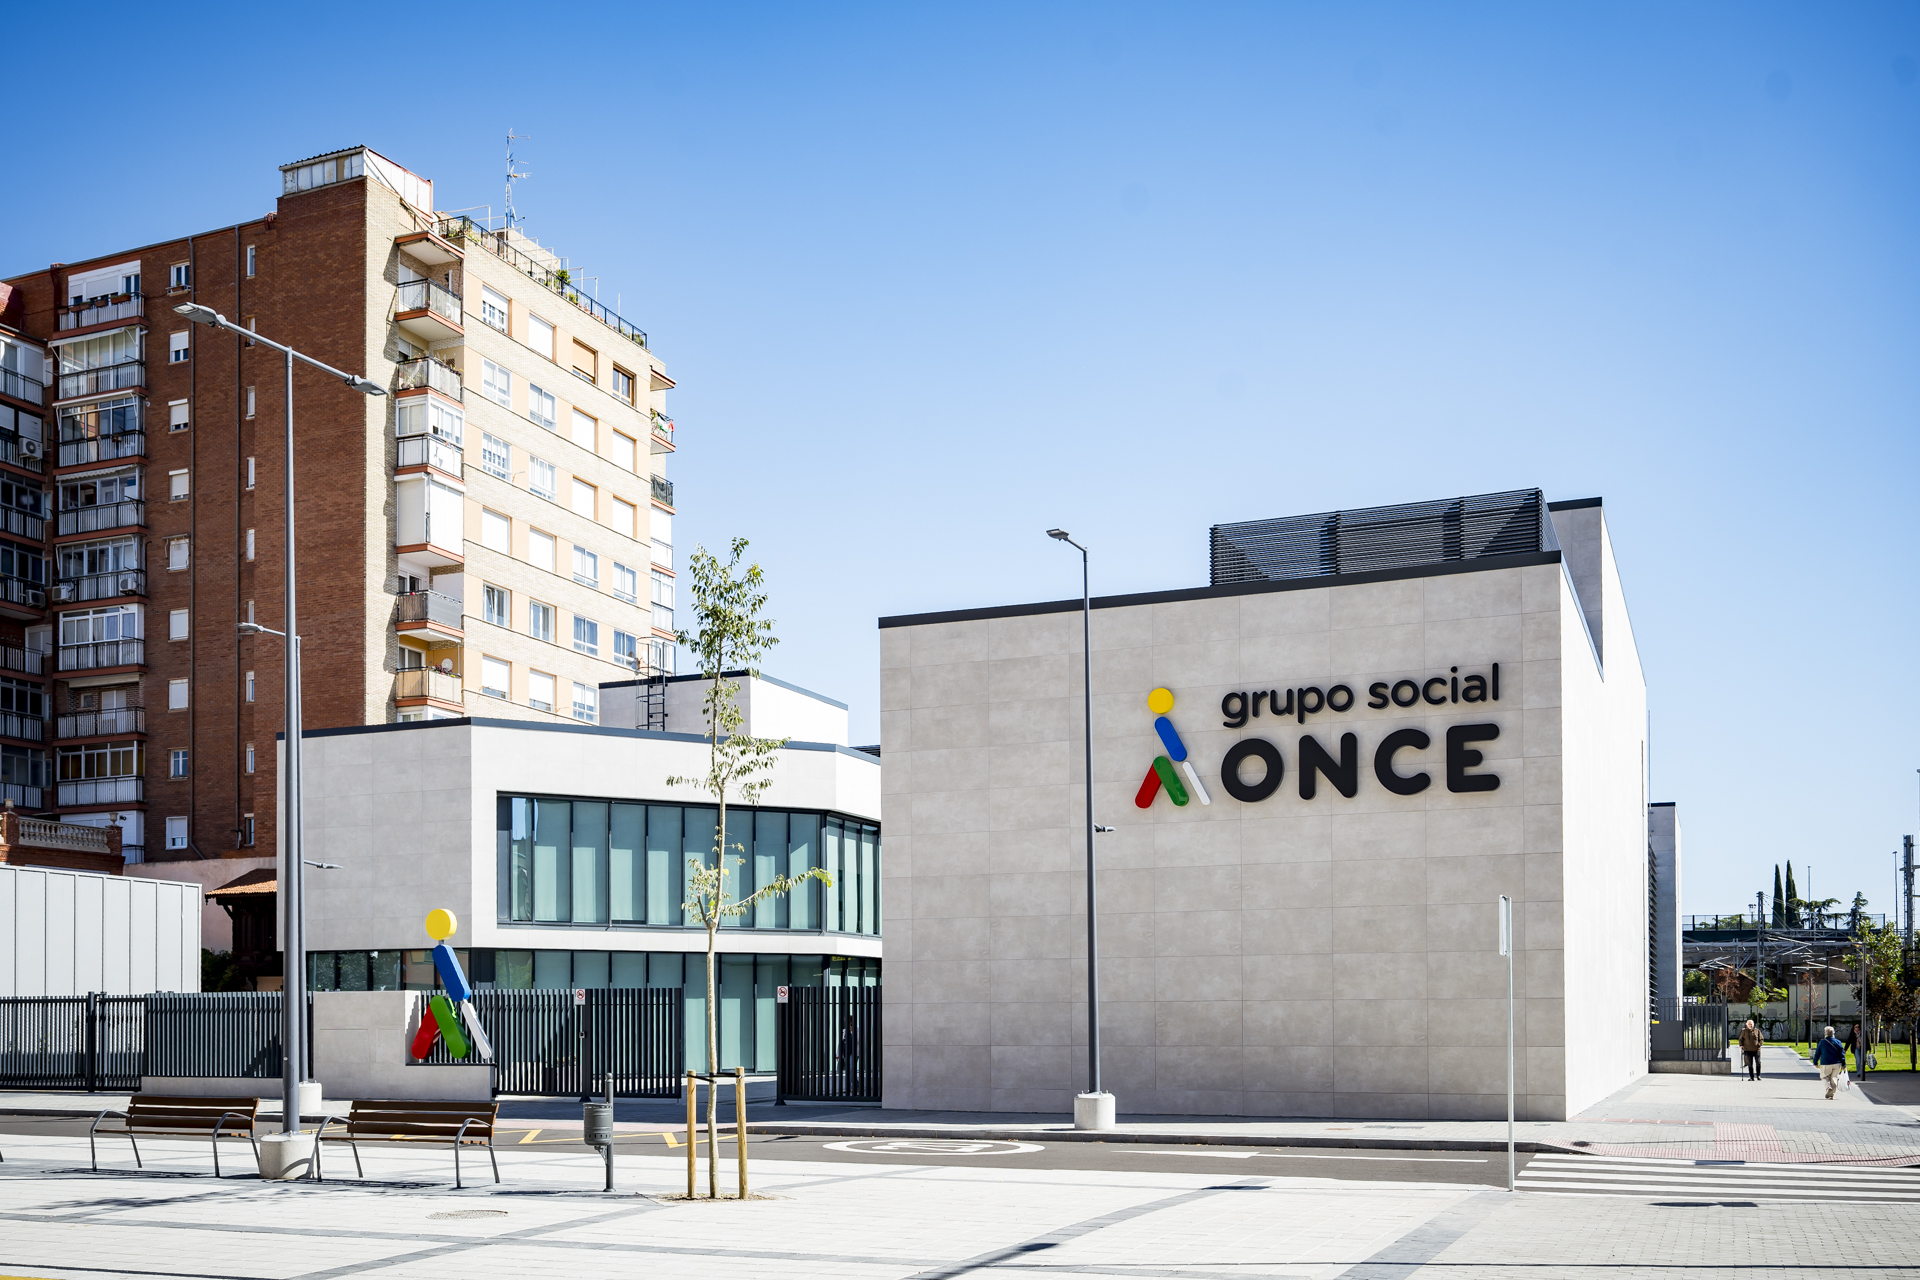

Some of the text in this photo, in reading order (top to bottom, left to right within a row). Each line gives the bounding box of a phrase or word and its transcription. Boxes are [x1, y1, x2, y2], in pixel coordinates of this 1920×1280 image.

[1221, 662, 1500, 729] grupo social
[1220, 722, 1501, 803] ONCE
